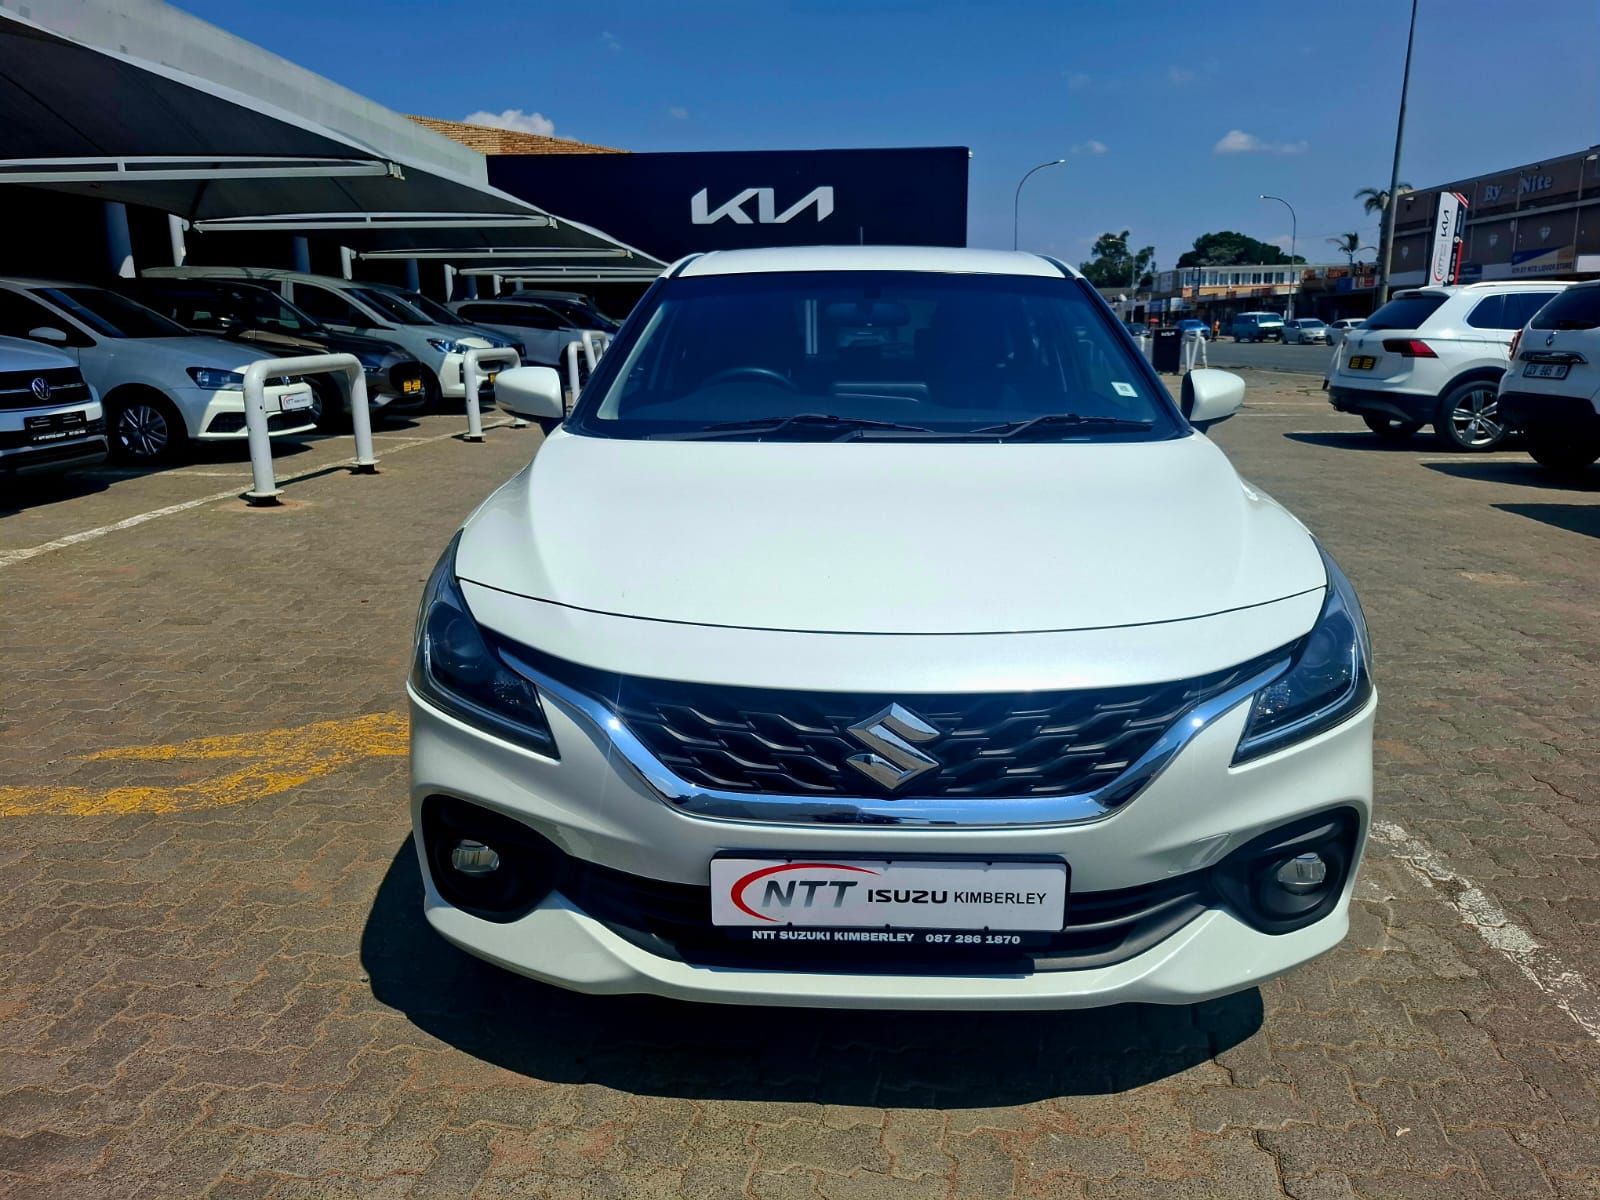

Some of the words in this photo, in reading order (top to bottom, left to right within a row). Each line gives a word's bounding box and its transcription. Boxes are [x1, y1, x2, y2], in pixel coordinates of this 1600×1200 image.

[691, 186, 834, 224] KIA
[1441, 210, 1450, 237] KIA
[761, 880, 858, 909] NTT
[867, 888, 948, 904] ISUZU
[953, 891, 1047, 905] KIMBERLEY
[752, 930, 777, 940] NTT
[779, 931, 831, 941] SUZUKI
[834, 932, 915, 942] KIMBERLEY
[925, 933, 952, 943] 087
[954, 934, 982, 944] 286
[985, 935, 1021, 945] 1870
